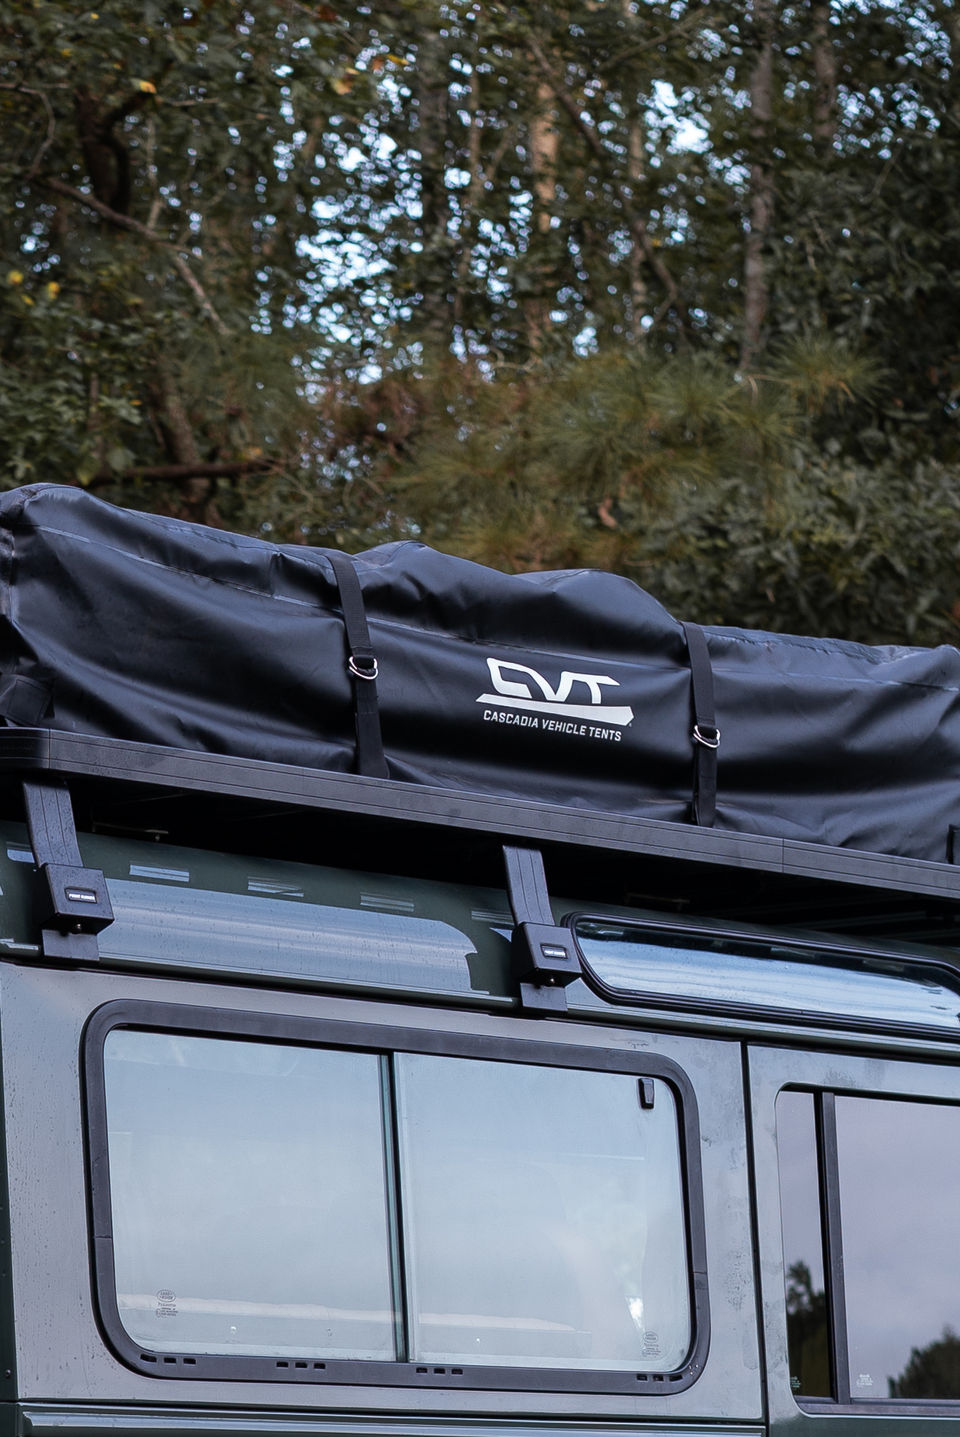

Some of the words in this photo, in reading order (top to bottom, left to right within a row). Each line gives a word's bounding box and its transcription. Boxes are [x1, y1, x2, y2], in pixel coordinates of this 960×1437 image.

[486, 657, 621, 705] CVT
[483, 710, 538, 729] CASCADIA
[542, 719, 587, 736] VEHICLE
[588, 726, 622, 742] TENTS
